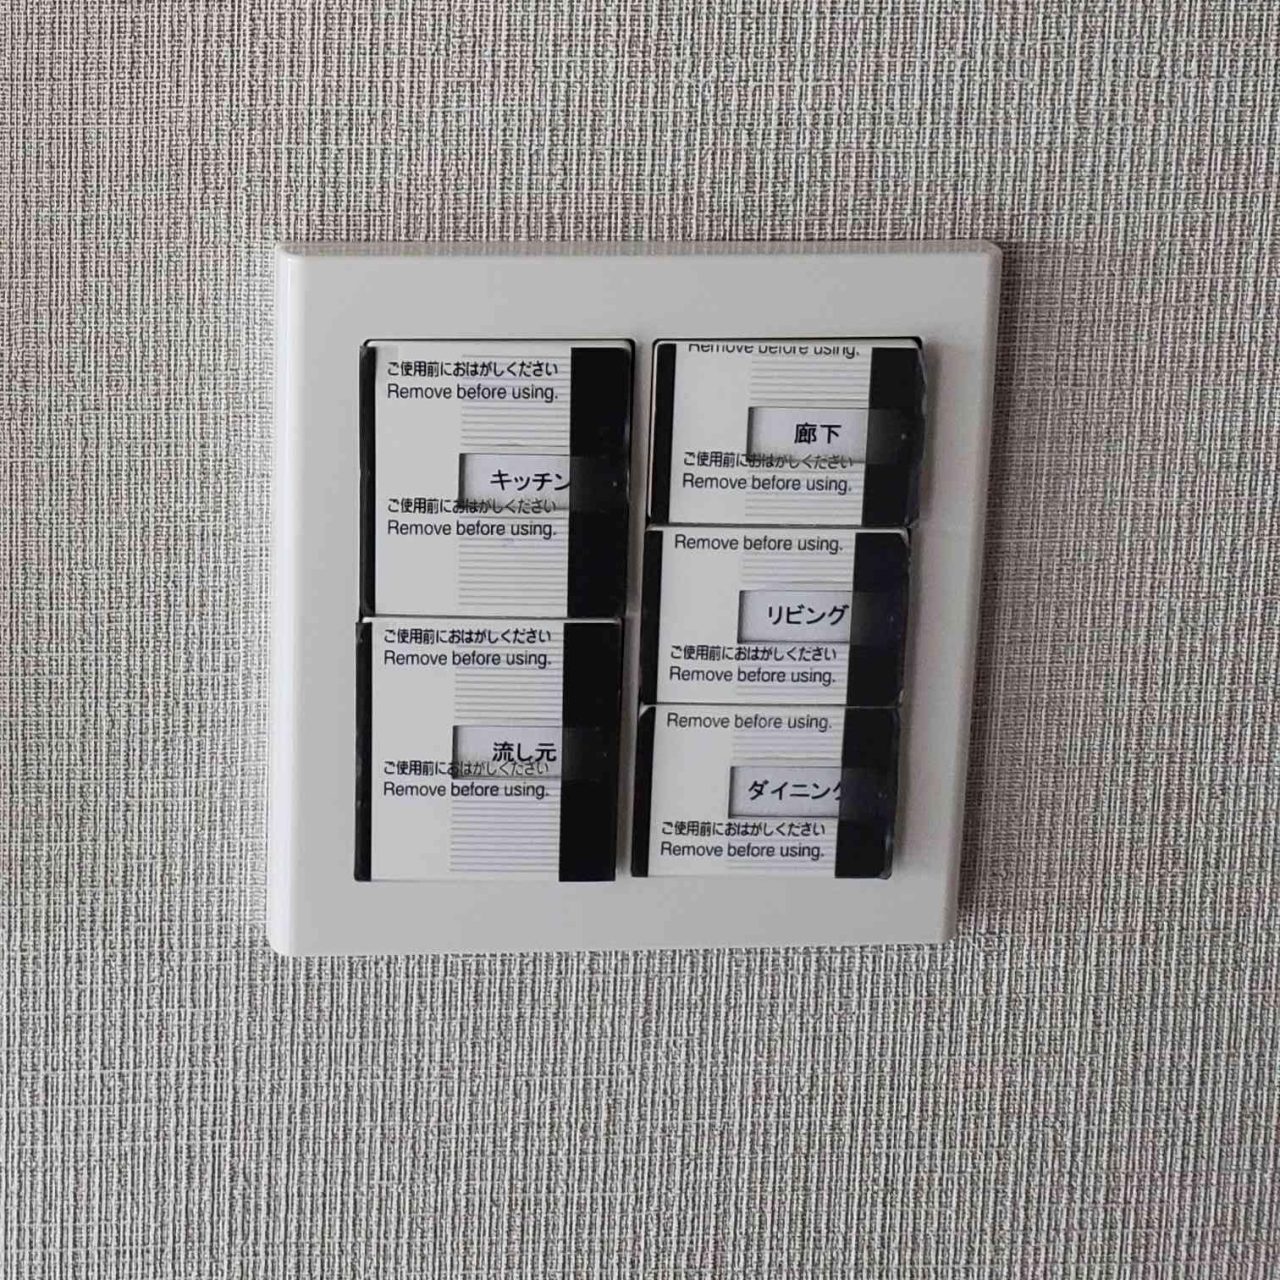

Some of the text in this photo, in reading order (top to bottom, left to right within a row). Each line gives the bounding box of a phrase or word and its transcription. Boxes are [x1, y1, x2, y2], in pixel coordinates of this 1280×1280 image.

[387, 361, 558, 377] ご使用前におはがしください
[387, 384, 558, 403] Remove before using.
[794, 422, 842, 444] 廊下
[490, 469, 570, 491] キッチン
[682, 473, 852, 495] Remove before using.
[387, 520, 556, 540] Remove before using.
[674, 534, 843, 555] Remove before using.
[769, 604, 849, 625] リビング
[384, 628, 551, 644] ご使用前におはがしください
[384, 650, 552, 669] Remove before using.
[670, 645, 836, 661] ご使用前におはがしください
[669, 667, 836, 687] Remove before using.
[667, 713, 832, 732] Remove before using.
[492, 741, 557, 762] 流し元
[384, 782, 549, 800] Remove before using.
[661, 821, 825, 836] ご使用前におはがしください
[661, 842, 825, 861] Remove before using.
